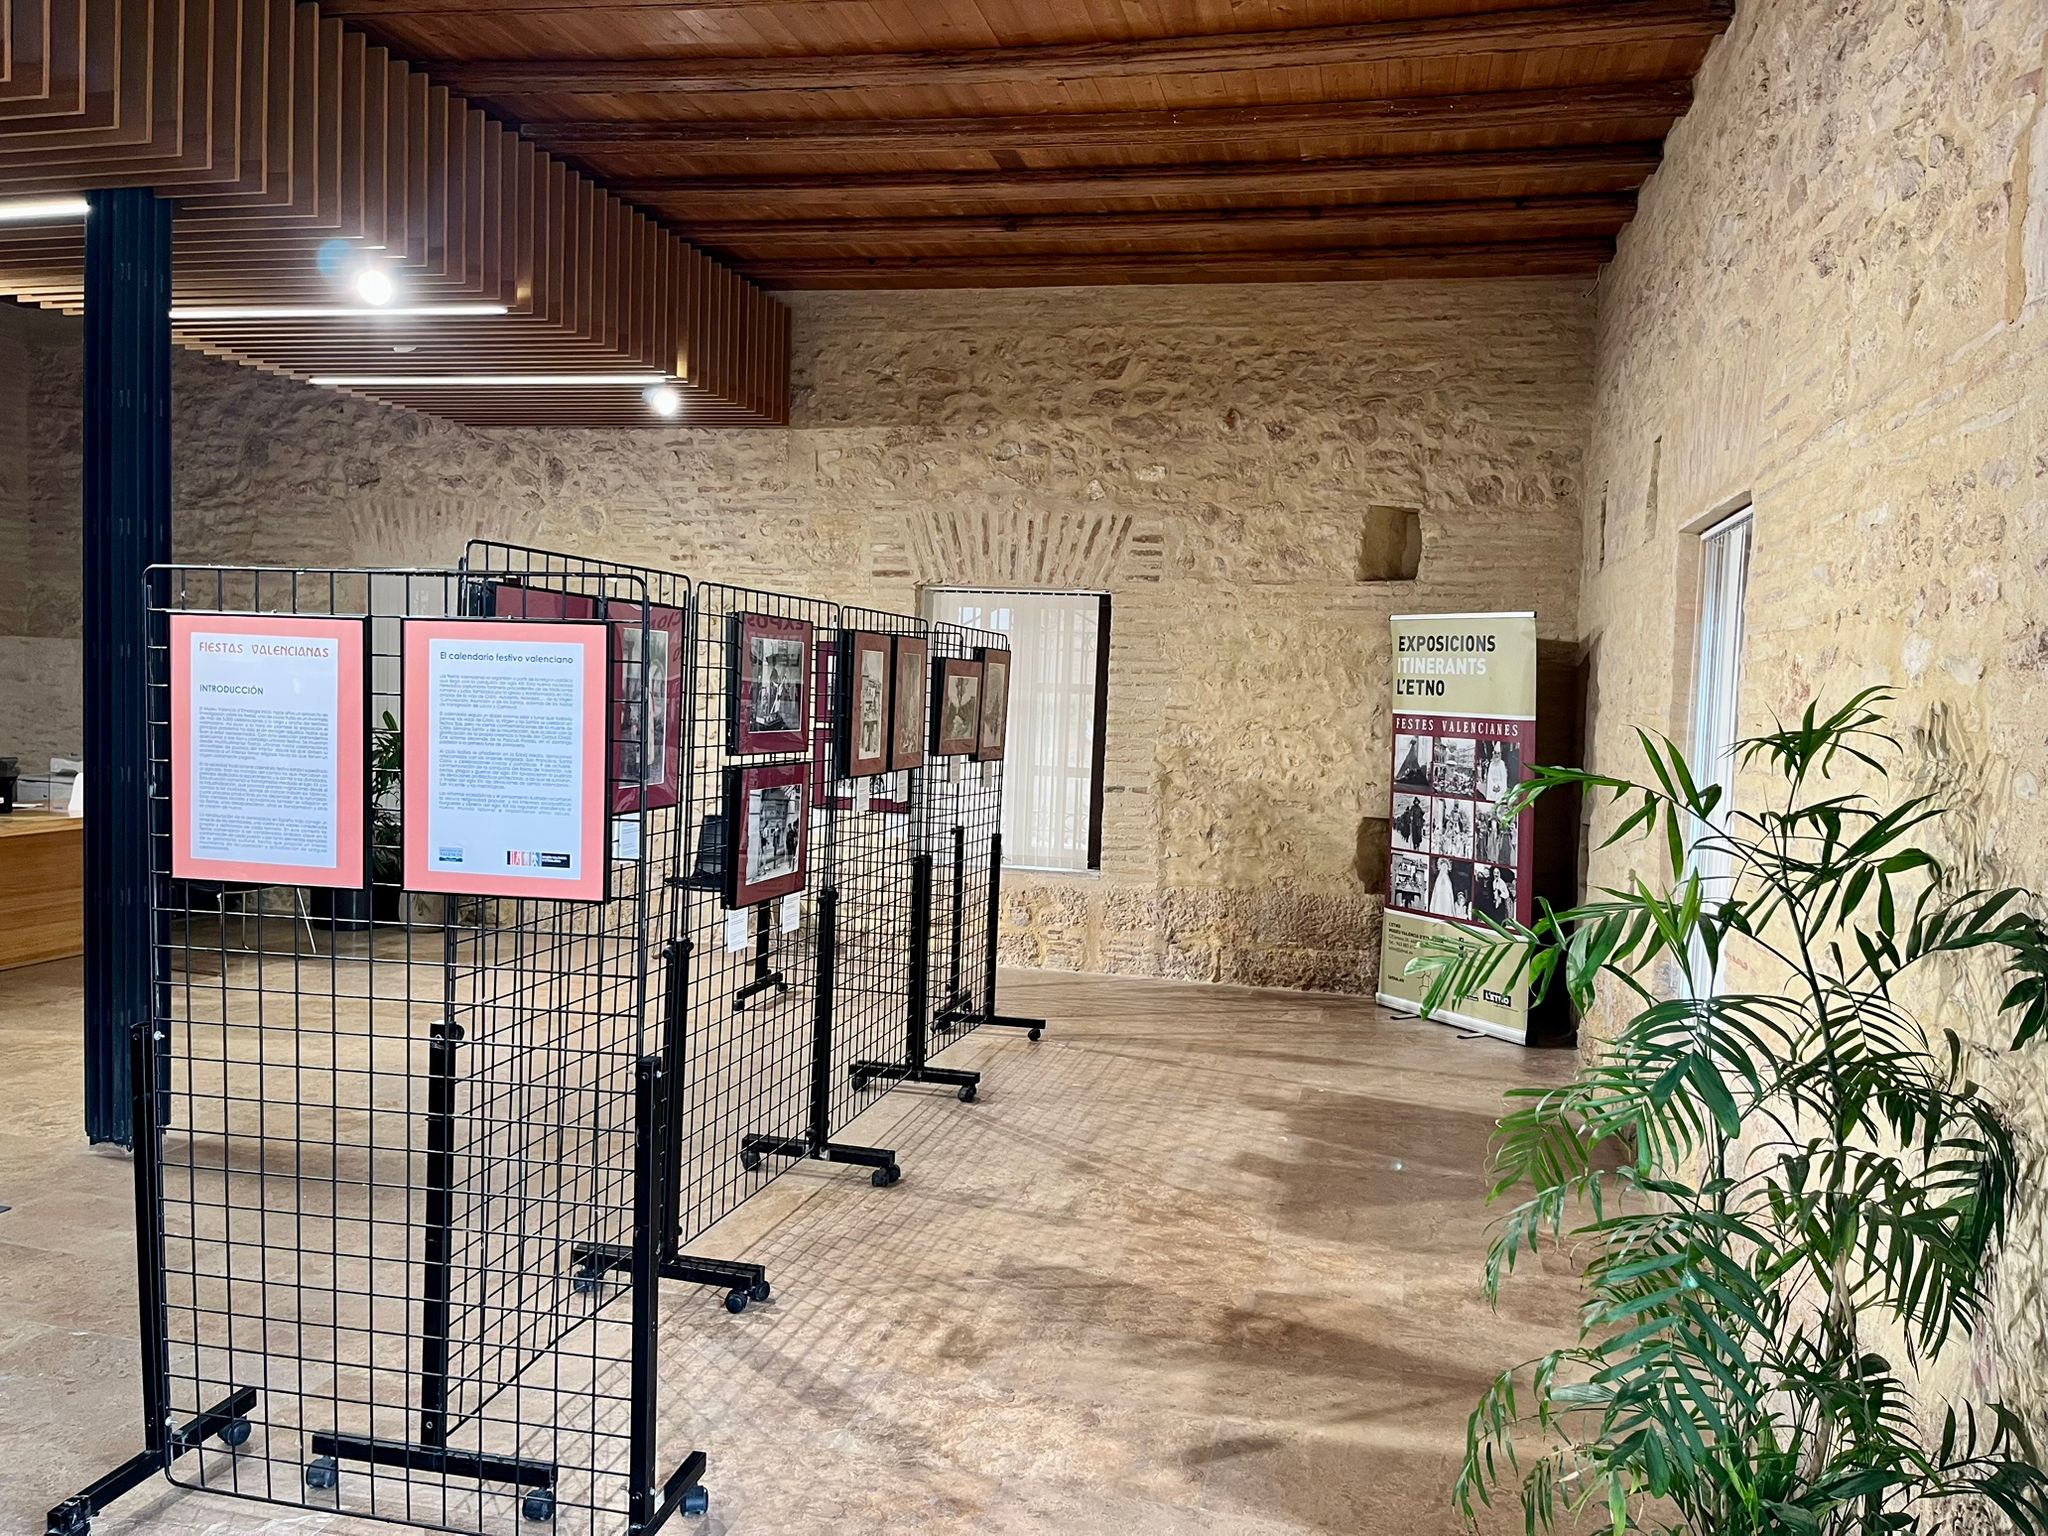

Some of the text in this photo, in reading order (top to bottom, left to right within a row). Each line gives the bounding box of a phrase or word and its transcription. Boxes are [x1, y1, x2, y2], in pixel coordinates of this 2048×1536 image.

[199, 641, 330, 659] FIESTAS VALENCIANAS
[1398, 634, 1496, 652] EXPOSICIONS
[440, 651, 575, 665] El calendario festivo valenciano
[1397, 657, 1487, 675] ITINERANTS
[199, 683, 263, 696] INTRODUCCIÓN
[1396, 679, 1445, 696] L'ETNO
[1395, 717, 1519, 737] FESTES VALENCIANES
